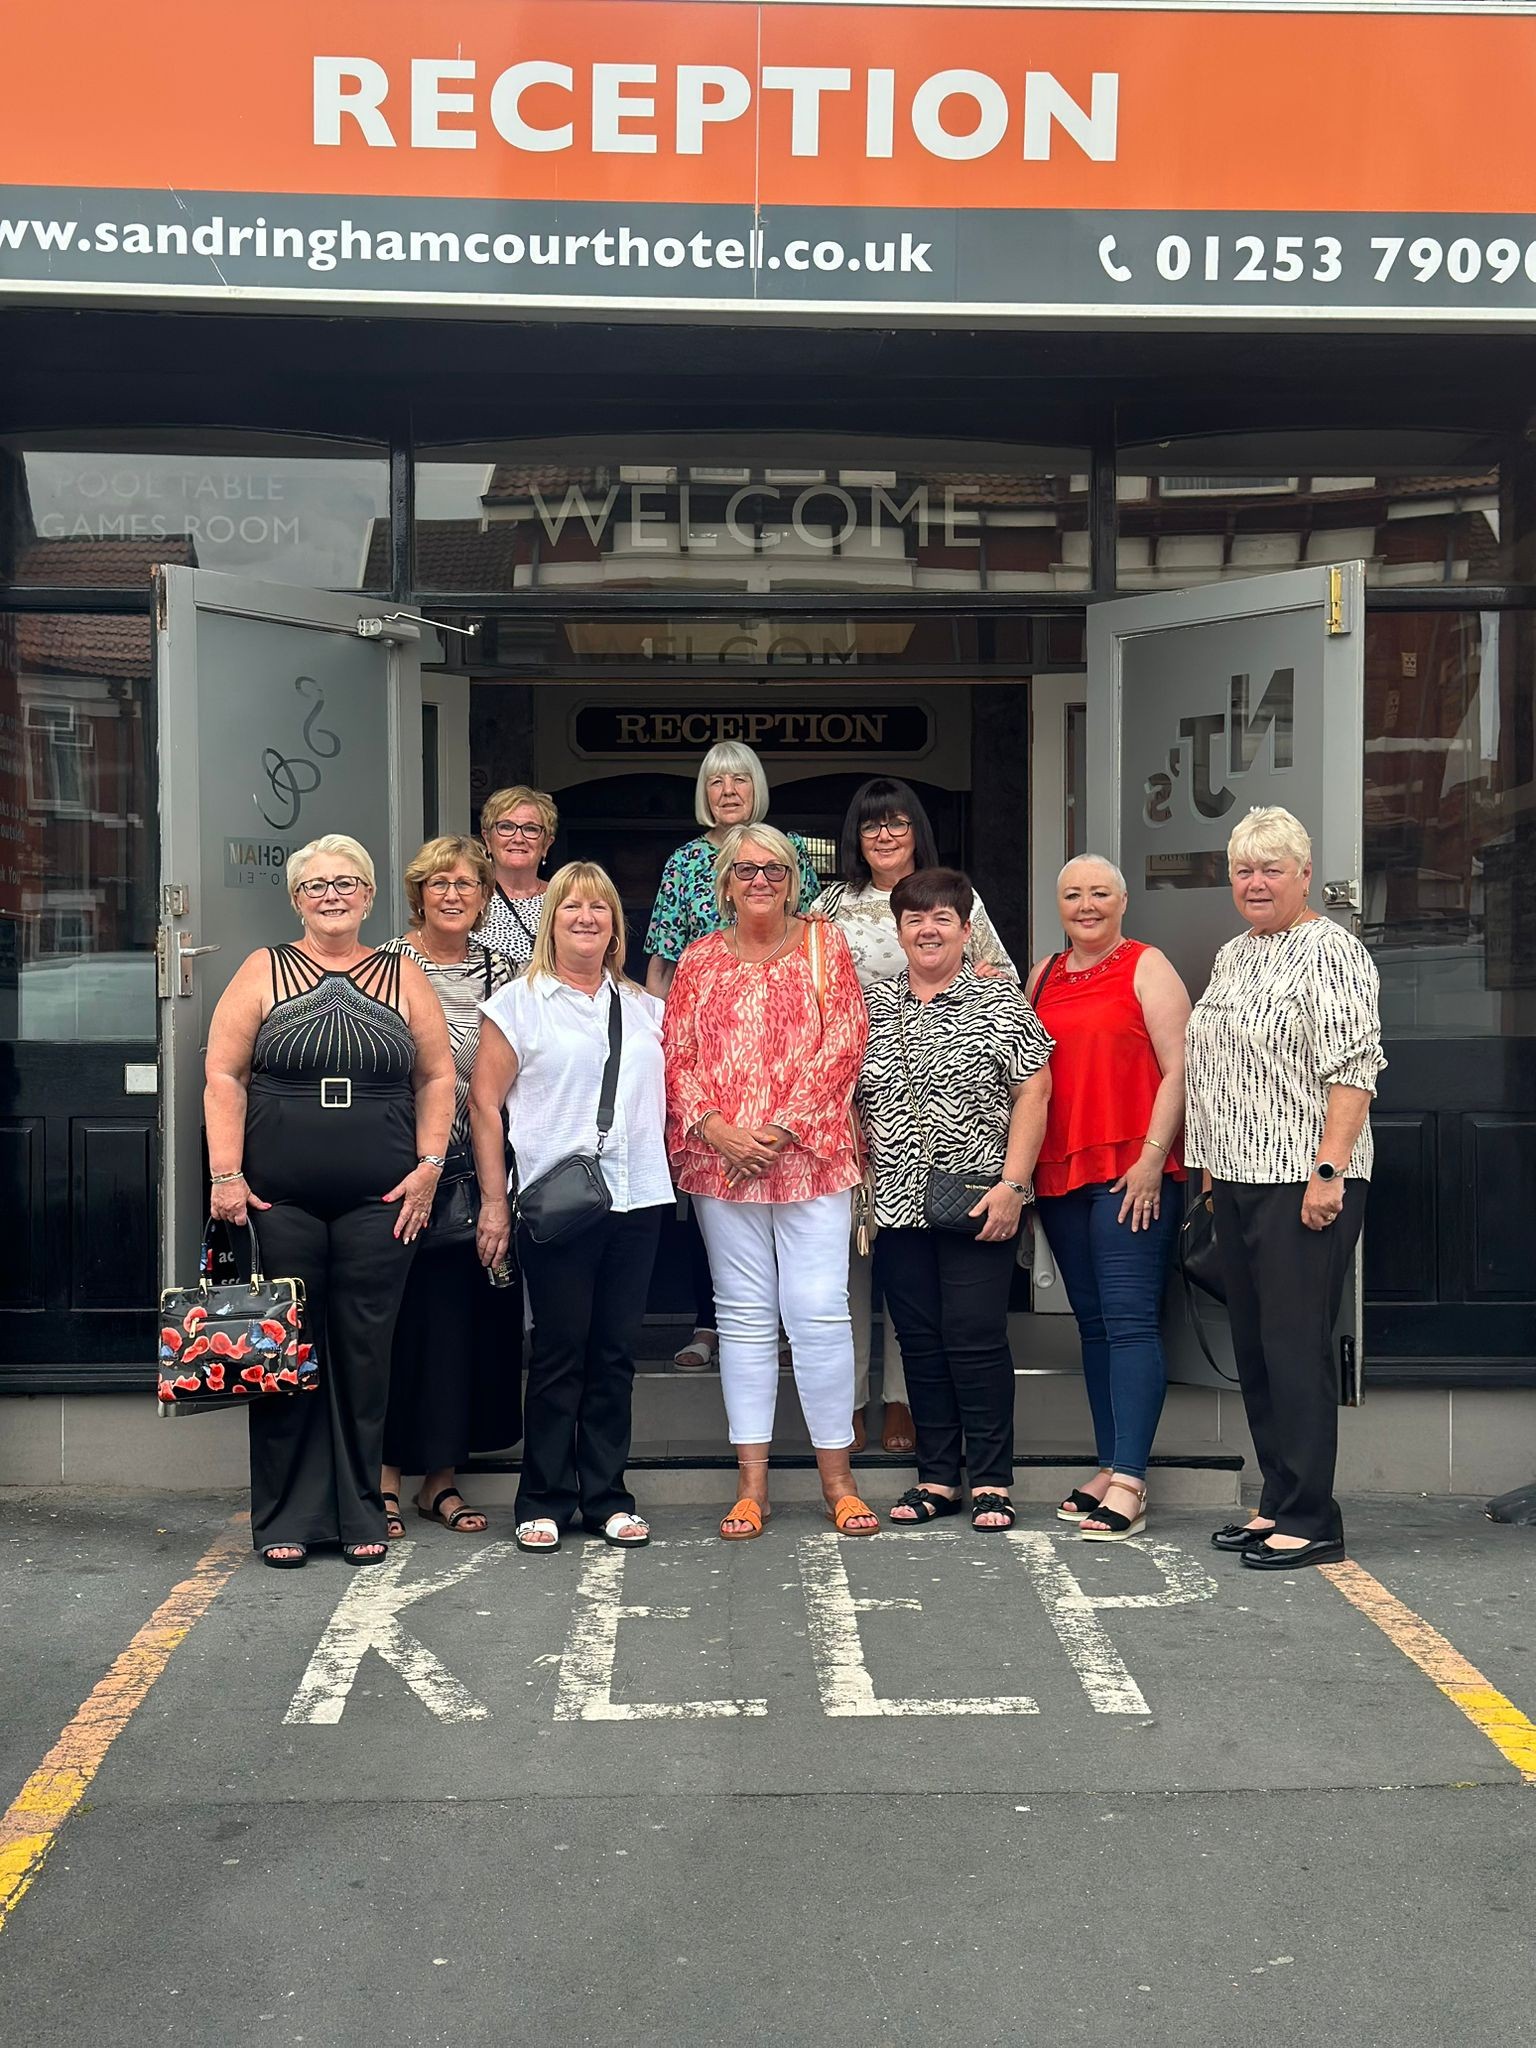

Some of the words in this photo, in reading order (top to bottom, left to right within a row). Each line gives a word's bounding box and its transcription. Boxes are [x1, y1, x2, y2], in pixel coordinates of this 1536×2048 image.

[313, 56, 1119, 162] RECEPTION
[1156, 235, 1343, 282] 01253
[56, 471, 162, 499] POOL
[180, 473, 285, 501] TABLE
[40, 513, 167, 542] GAMES
[184, 515, 301, 545] ROOM
[530, 484, 981, 548] WELCOME
[616, 714, 888, 744] RECEPTION
[282, 1530, 1219, 1726] KEEP
